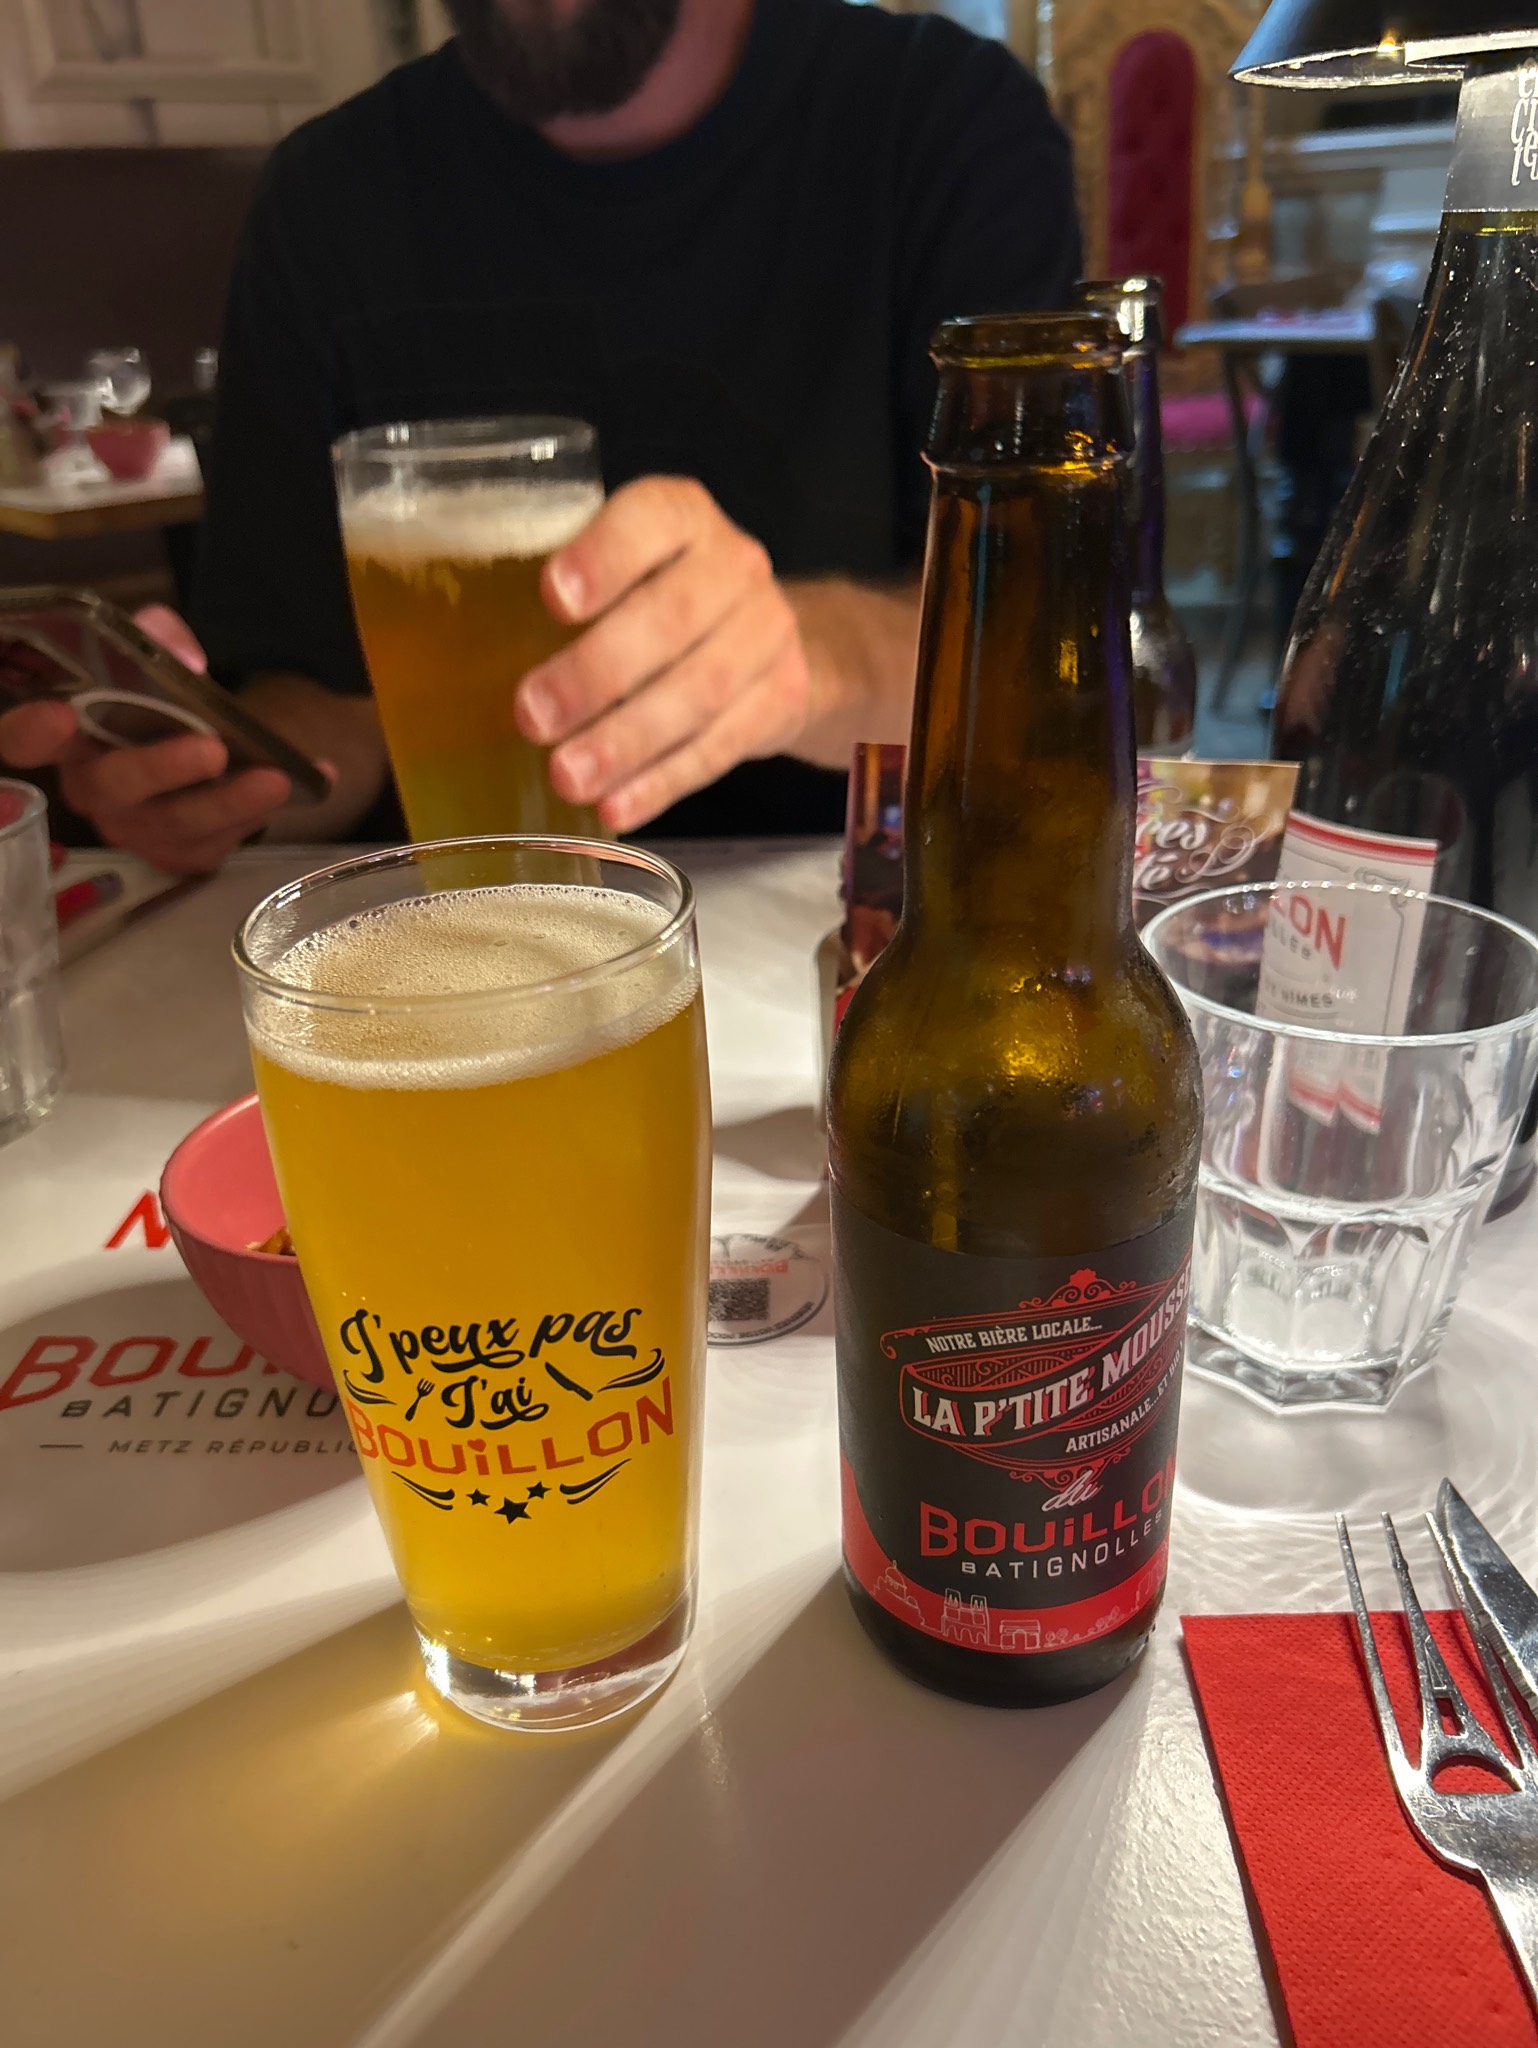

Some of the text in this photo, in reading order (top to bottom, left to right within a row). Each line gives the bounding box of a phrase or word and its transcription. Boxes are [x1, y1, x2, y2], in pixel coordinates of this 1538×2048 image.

[340, 1308, 643, 1384] J'peux pas
[925, 1332, 977, 1354] NOTRE
[979, 1325, 1028, 1347] BIÈRE
[441, 1375, 549, 1431] J'ai
[912, 1386, 965, 1437] LA
[973, 1366, 1095, 1437] P'TITE
[108, 1439, 193, 1454] METZ
[961, 1509, 1162, 1579] BATIGNOLLES
